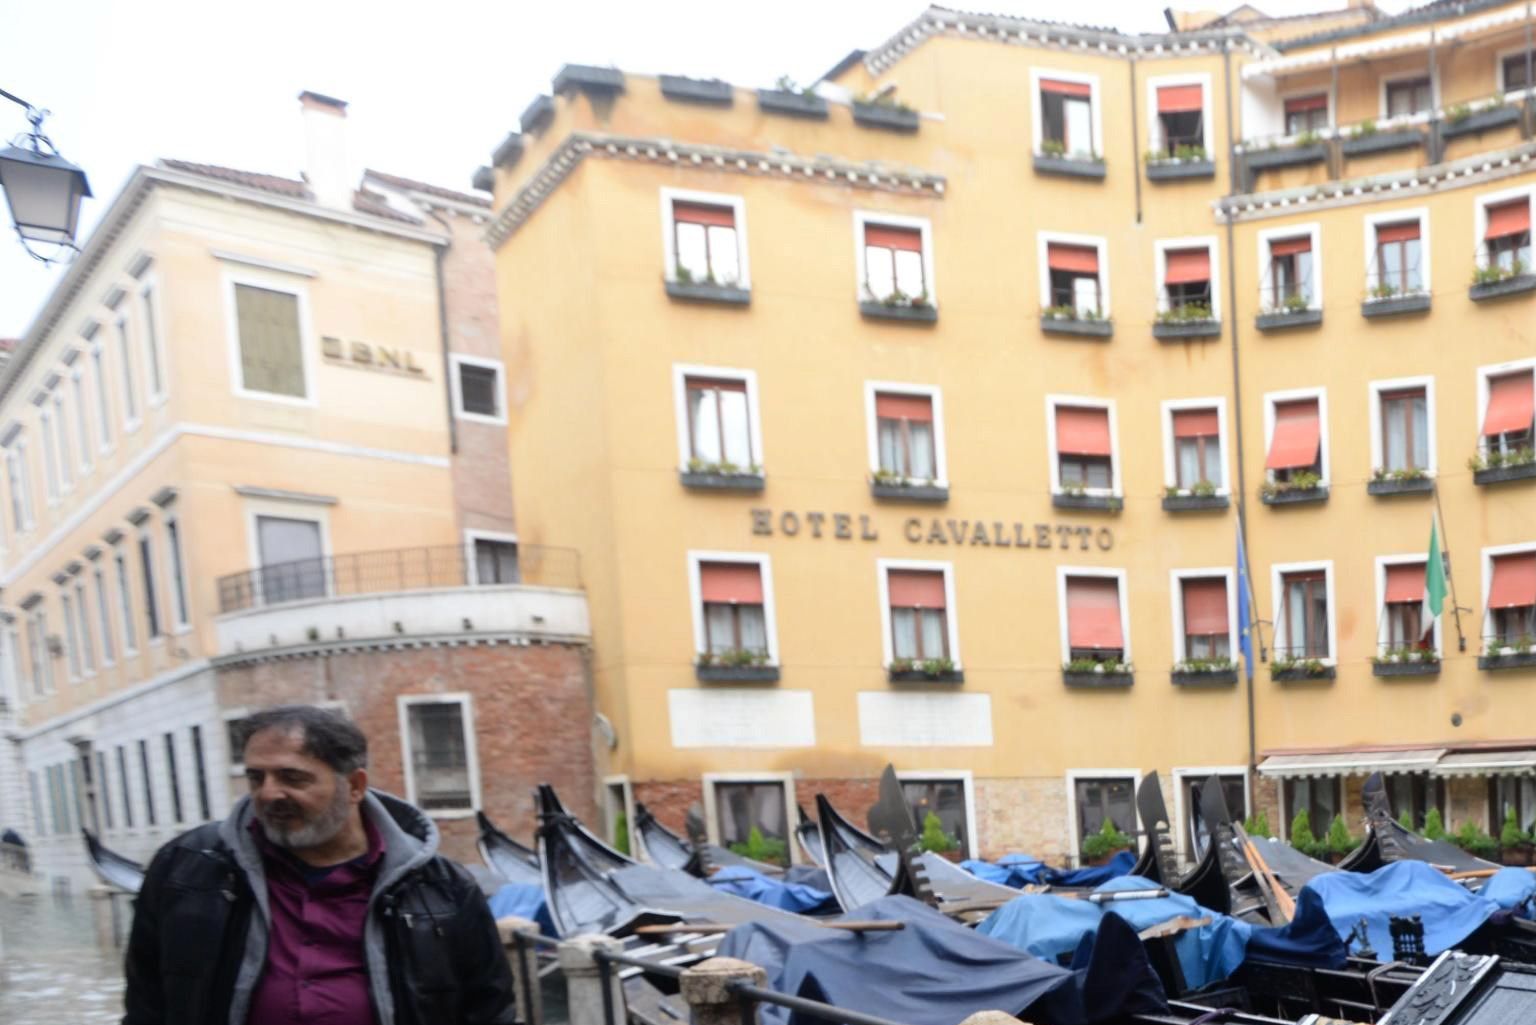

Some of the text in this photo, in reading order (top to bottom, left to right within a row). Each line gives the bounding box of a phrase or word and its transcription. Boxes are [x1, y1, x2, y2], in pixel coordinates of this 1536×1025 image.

[351, 341, 425, 374] BNL
[750, 508, 1115, 551] HOTEL CAVALLETTO
